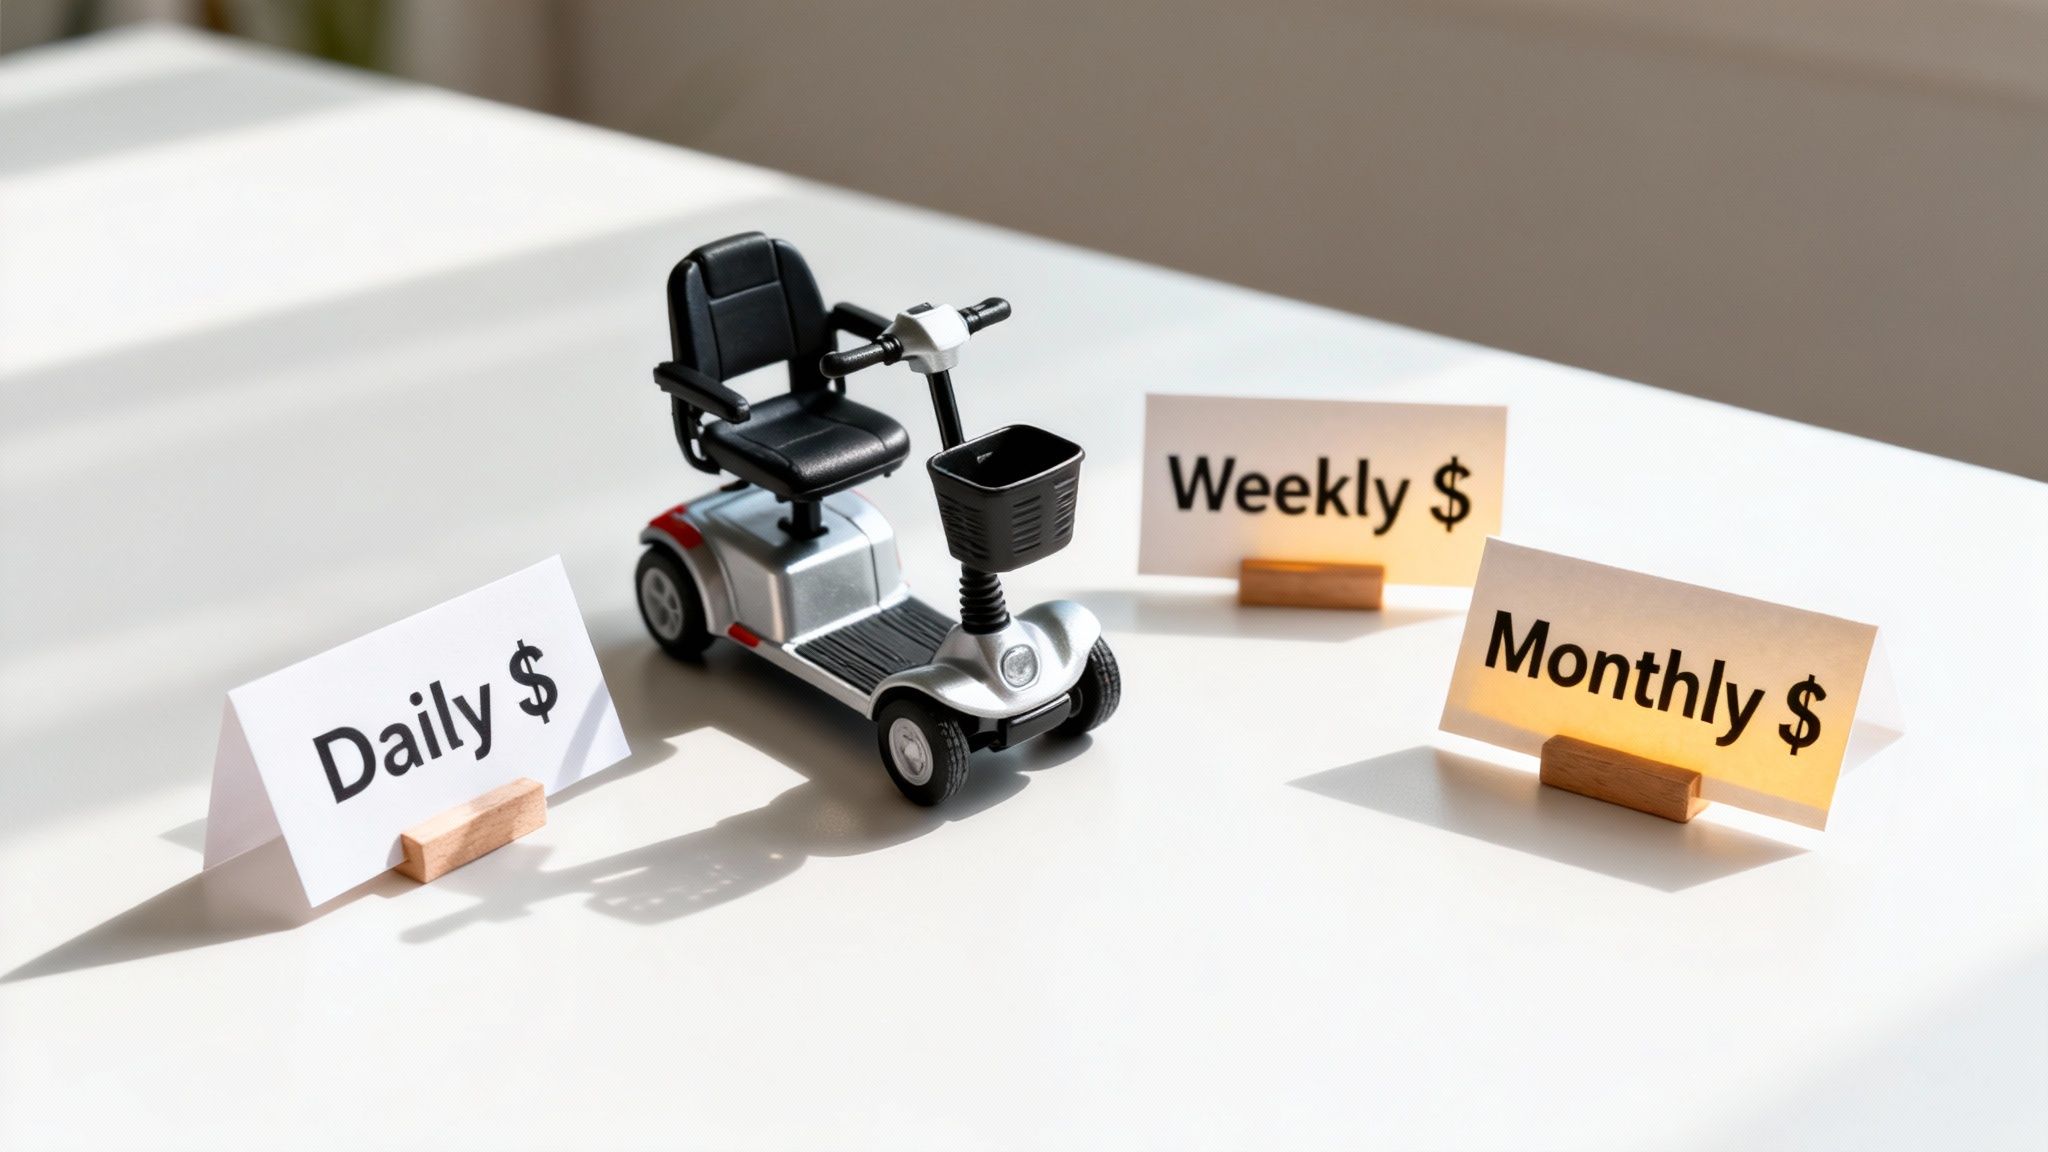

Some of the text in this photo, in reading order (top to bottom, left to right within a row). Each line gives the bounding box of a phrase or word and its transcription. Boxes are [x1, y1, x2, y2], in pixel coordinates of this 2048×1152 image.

[1167, 455, 1472, 536] Weekly $
[313, 639, 559, 804] Daily $
[1485, 609, 1828, 757] Monthly $
